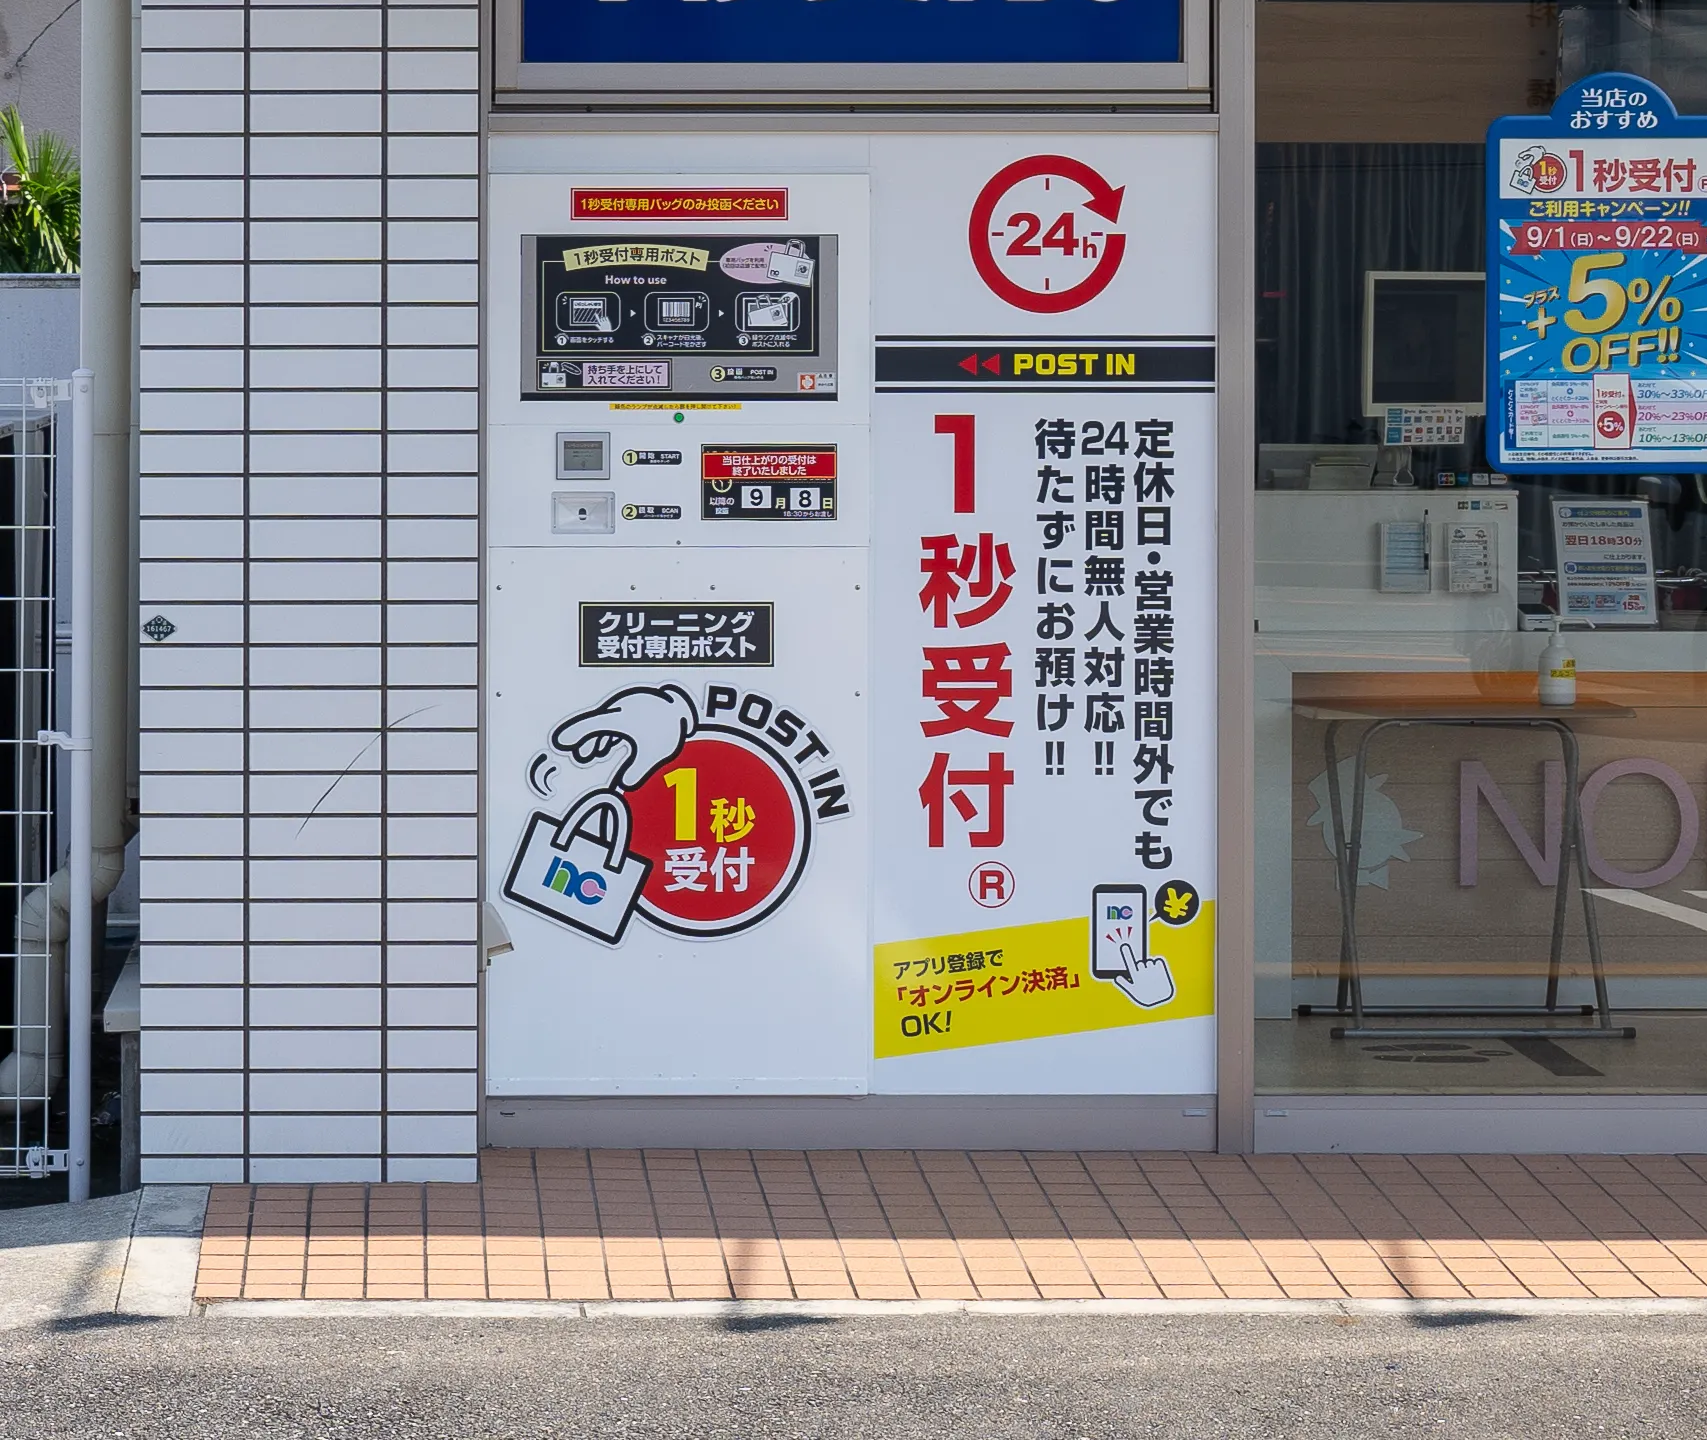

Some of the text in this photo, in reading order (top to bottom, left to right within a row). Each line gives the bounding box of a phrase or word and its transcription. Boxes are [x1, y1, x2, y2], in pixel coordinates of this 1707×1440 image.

[1581, 88, 1647, 108] 当店の
[1570, 111, 1658, 129] おすすめ
[1539, 161, 1557, 174] 1秒
[1539, 175, 1557, 185] 受付
[581, 198, 778, 211] 1秒受付専用バッグのみ投函ください
[574, 247, 701, 266] 1秒受付専用ポスト
[605, 275, 667, 284] How to use
[588, 365, 662, 374] 持ち手を上にして
[1014, 354, 1135, 375] POST IN
[588, 375, 661, 384] 入れてください!
[722, 455, 816, 465] 当日仕上がりの受付は
[732, 466, 806, 476] 終了いたしました
[750, 488, 833, 509] 9 月 8 日
[1565, 535, 1642, 546] 翌日18時30分
[598, 611, 756, 634] クリーニング
[598, 636, 757, 659] 受付専用ポスト
[1133, 419, 1175, 870] 定休日・営業時間外でも
[705, 684, 850, 819] POST IN
[663, 767, 756, 843] 1秒
[663, 846, 755, 892] 受付
[893, 949, 1004, 981] アプリ登録で
[895, 976, 1081, 1008] 「オンライン決済」
[900, 1011, 952, 1040] OK!
